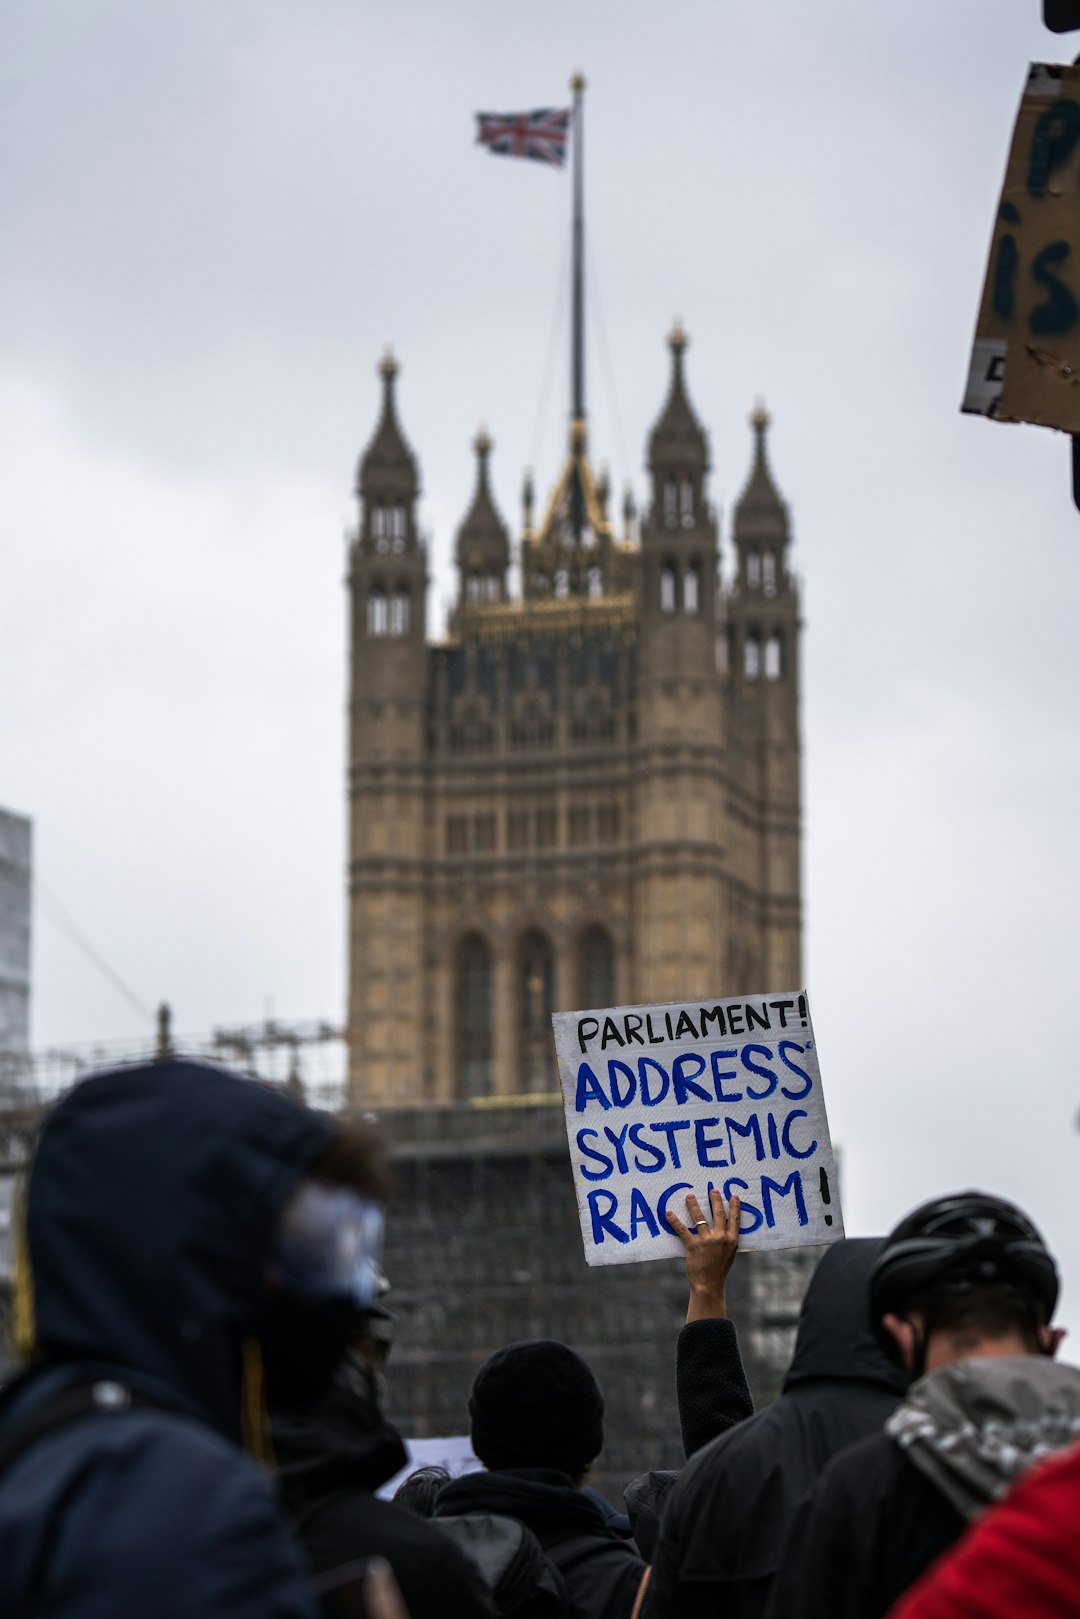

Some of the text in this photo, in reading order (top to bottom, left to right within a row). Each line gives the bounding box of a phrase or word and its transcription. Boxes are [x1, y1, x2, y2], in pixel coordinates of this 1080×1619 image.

[577, 994, 808, 1054] PARLIAMENT!
[575, 1040, 813, 1112] ADDRESS
[576, 1109, 818, 1181] SYSTEMIC
